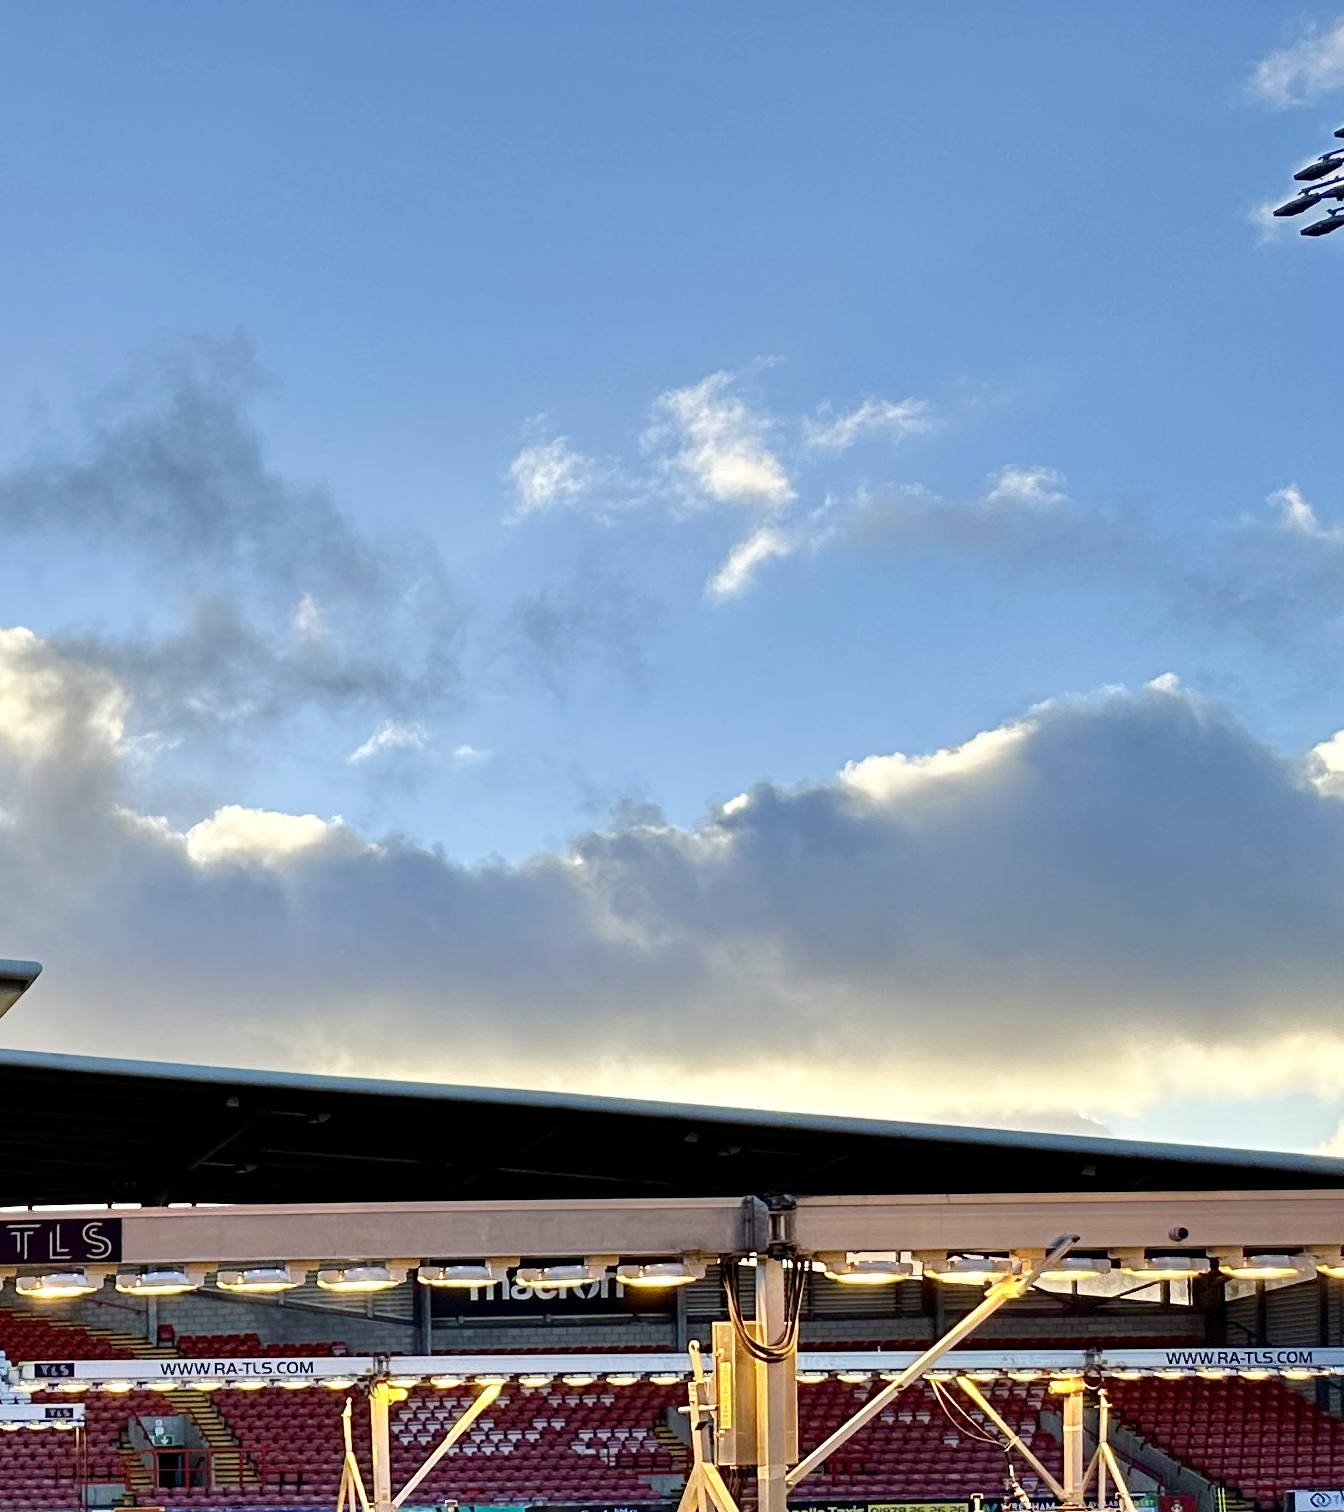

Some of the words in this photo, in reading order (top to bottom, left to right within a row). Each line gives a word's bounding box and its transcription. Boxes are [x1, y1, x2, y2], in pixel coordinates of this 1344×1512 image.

[5, 1222, 113, 1261] TLS
[1165, 1351, 1313, 1365] WWW.RA-TLS.COM
[160, 1361, 314, 1375] WWW.RA-TLS.COM
